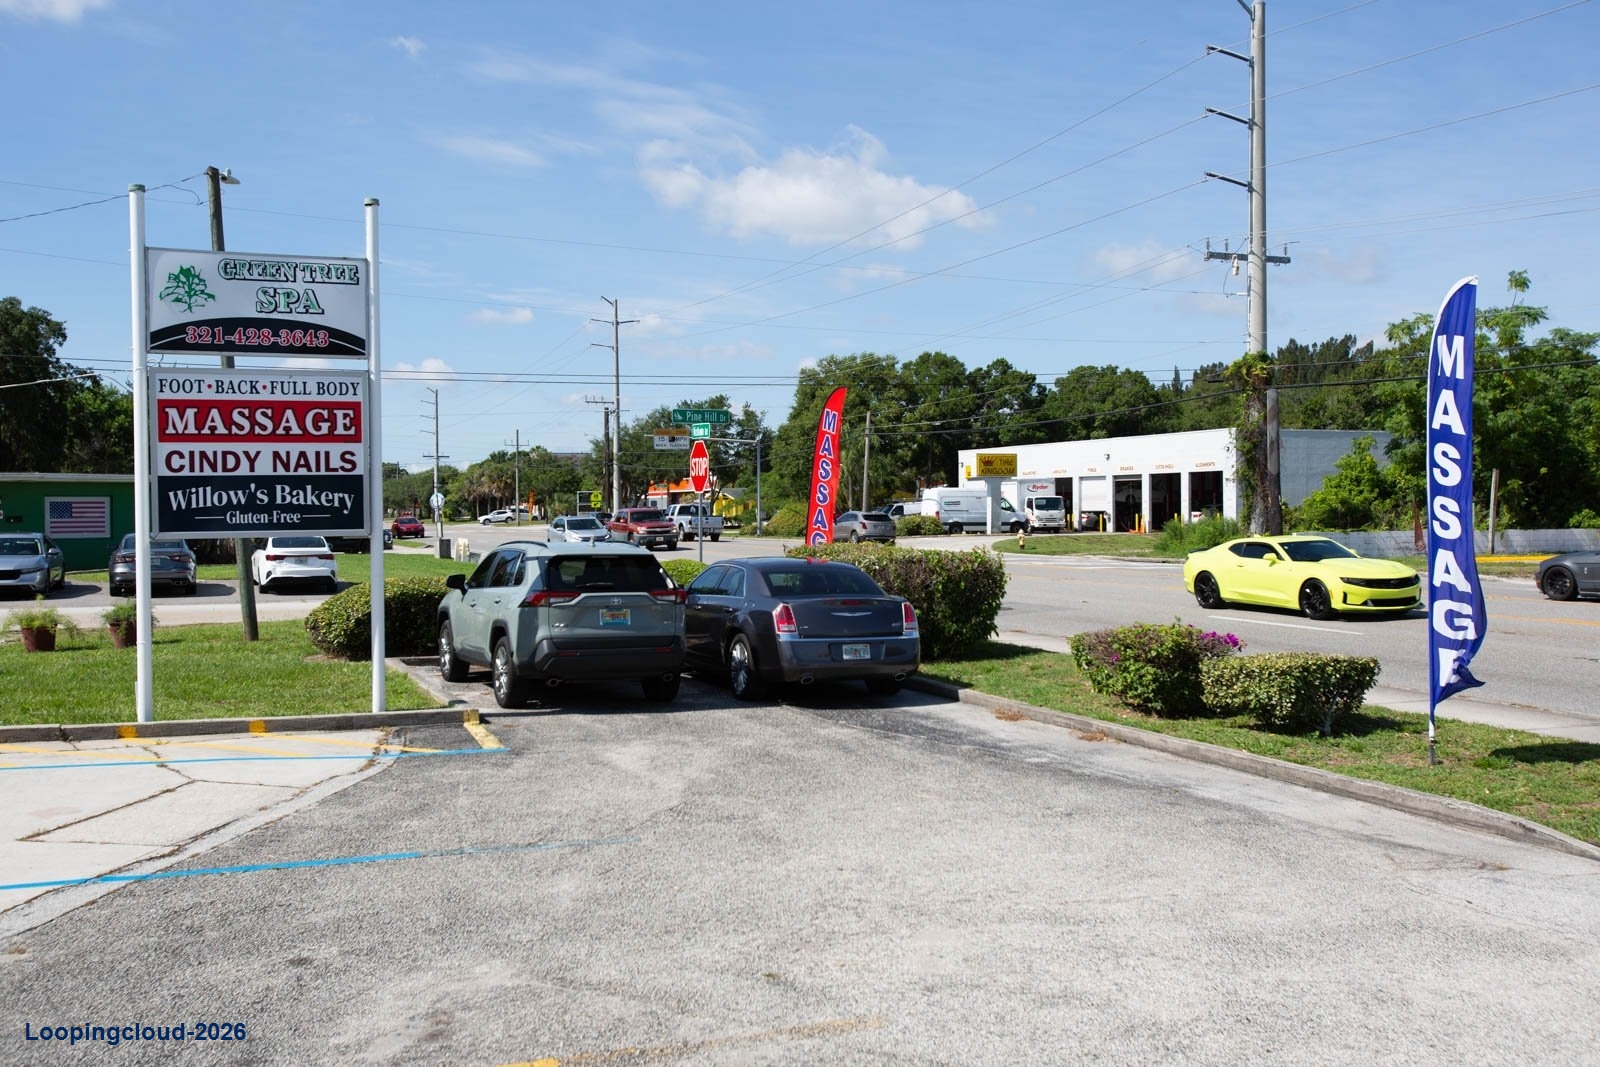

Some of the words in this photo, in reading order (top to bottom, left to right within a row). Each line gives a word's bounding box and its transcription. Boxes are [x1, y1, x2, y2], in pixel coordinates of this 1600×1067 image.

[217, 258, 297, 282] GREEN
[299, 263, 360, 285] TREE
[255, 287, 325, 315] SPA
[185, 326, 329, 347] 321-428-3643
[158, 378, 204, 394] FOOT
[214, 380, 260, 395] BACK
[269, 381, 312, 396] FULL
[316, 382, 360, 397] BODY
[164, 407, 356, 436] MASSAGE
[686, 411, 702, 422] Pine
[704, 411, 718, 422] Hill
[165, 450, 261, 473] CINDY
[272, 450, 357, 474] NAILS
[691, 458, 708, 476] STOP
[980, 467, 1016, 475] KINGDOM
[998, 459, 1013, 467] TIRE
[811, 409, 838, 547] MASSAG
[168, 483, 269, 512] Willow's
[275, 485, 355, 515] Bakery
[226, 510, 301, 525] Gluten-Free
